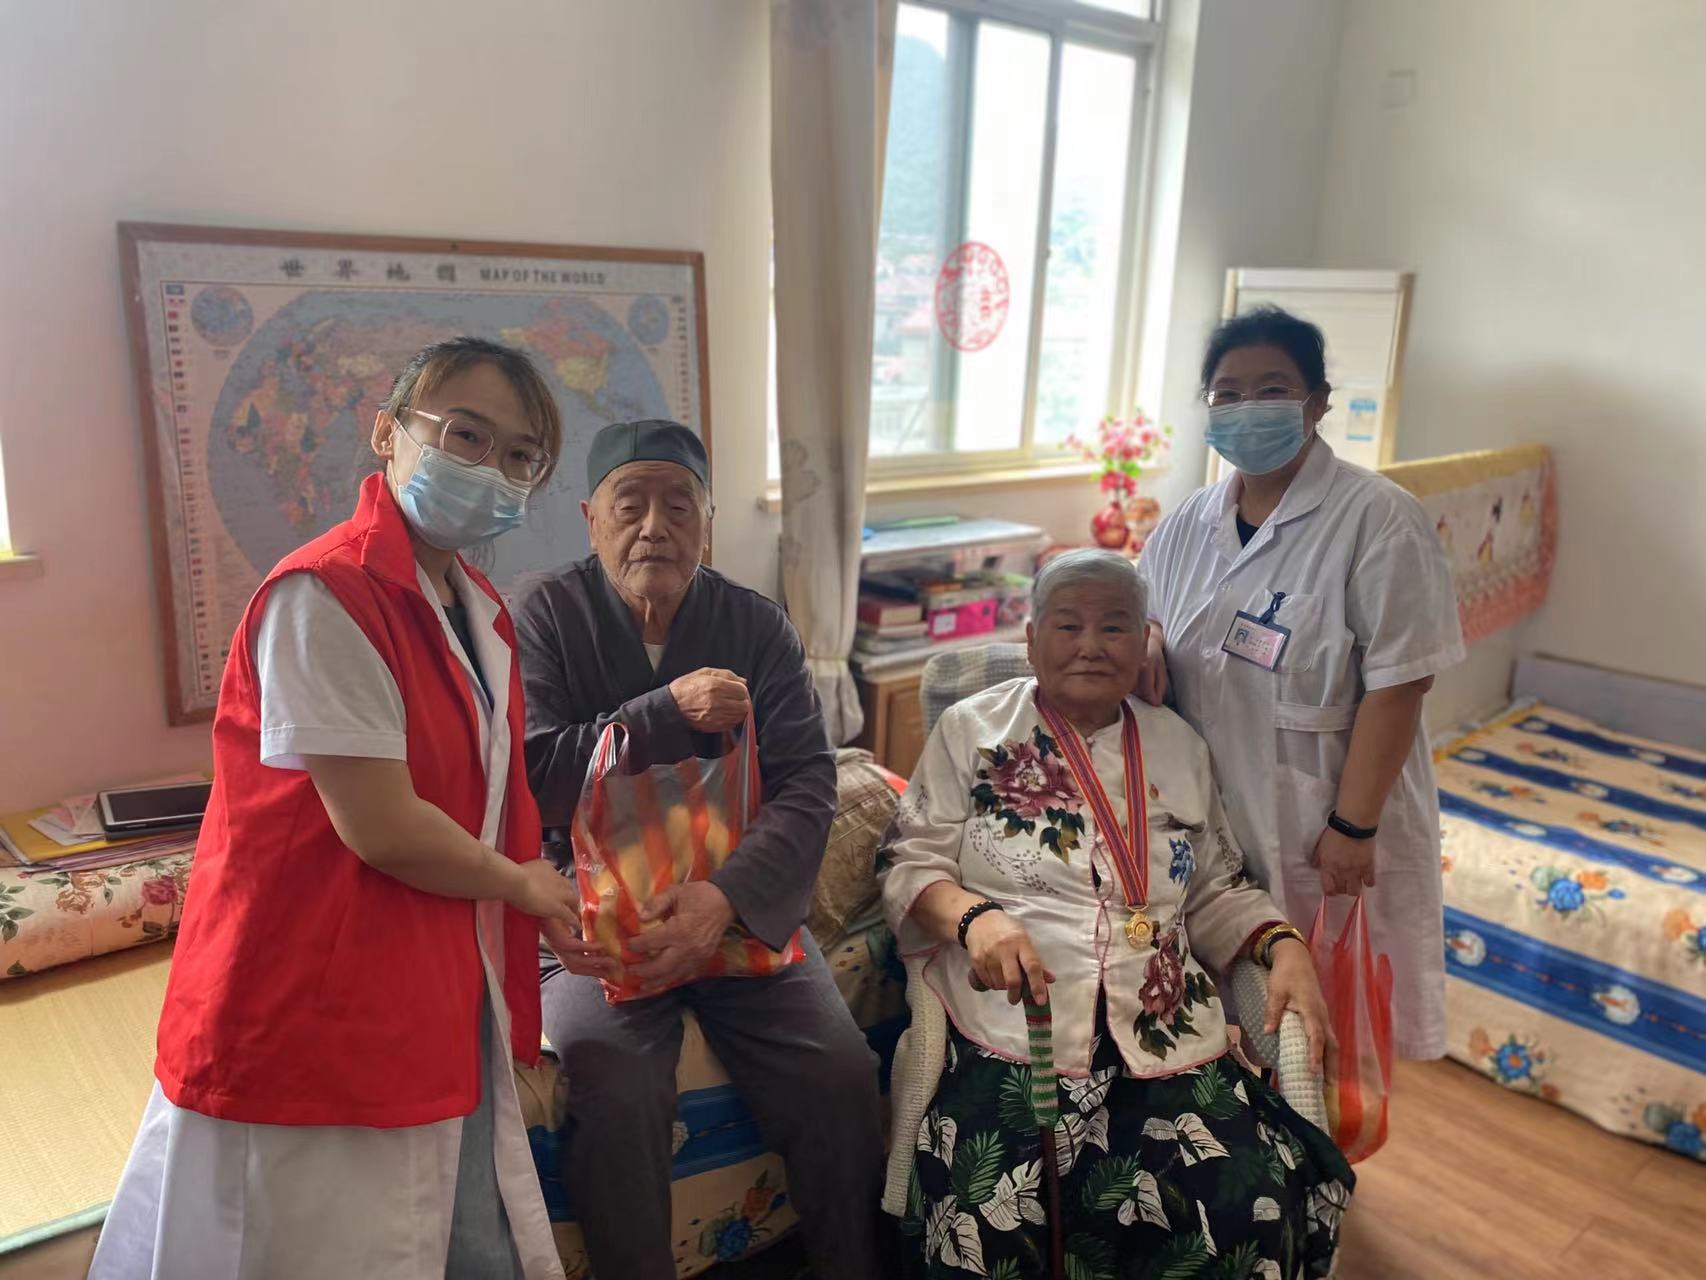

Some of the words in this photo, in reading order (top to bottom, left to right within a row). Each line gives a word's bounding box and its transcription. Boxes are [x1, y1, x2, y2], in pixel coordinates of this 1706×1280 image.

[480, 268, 509, 280] MAP
[512, 269, 529, 282] OF
[532, 269, 558, 283] THE
[561, 271, 606, 285] WORLD
